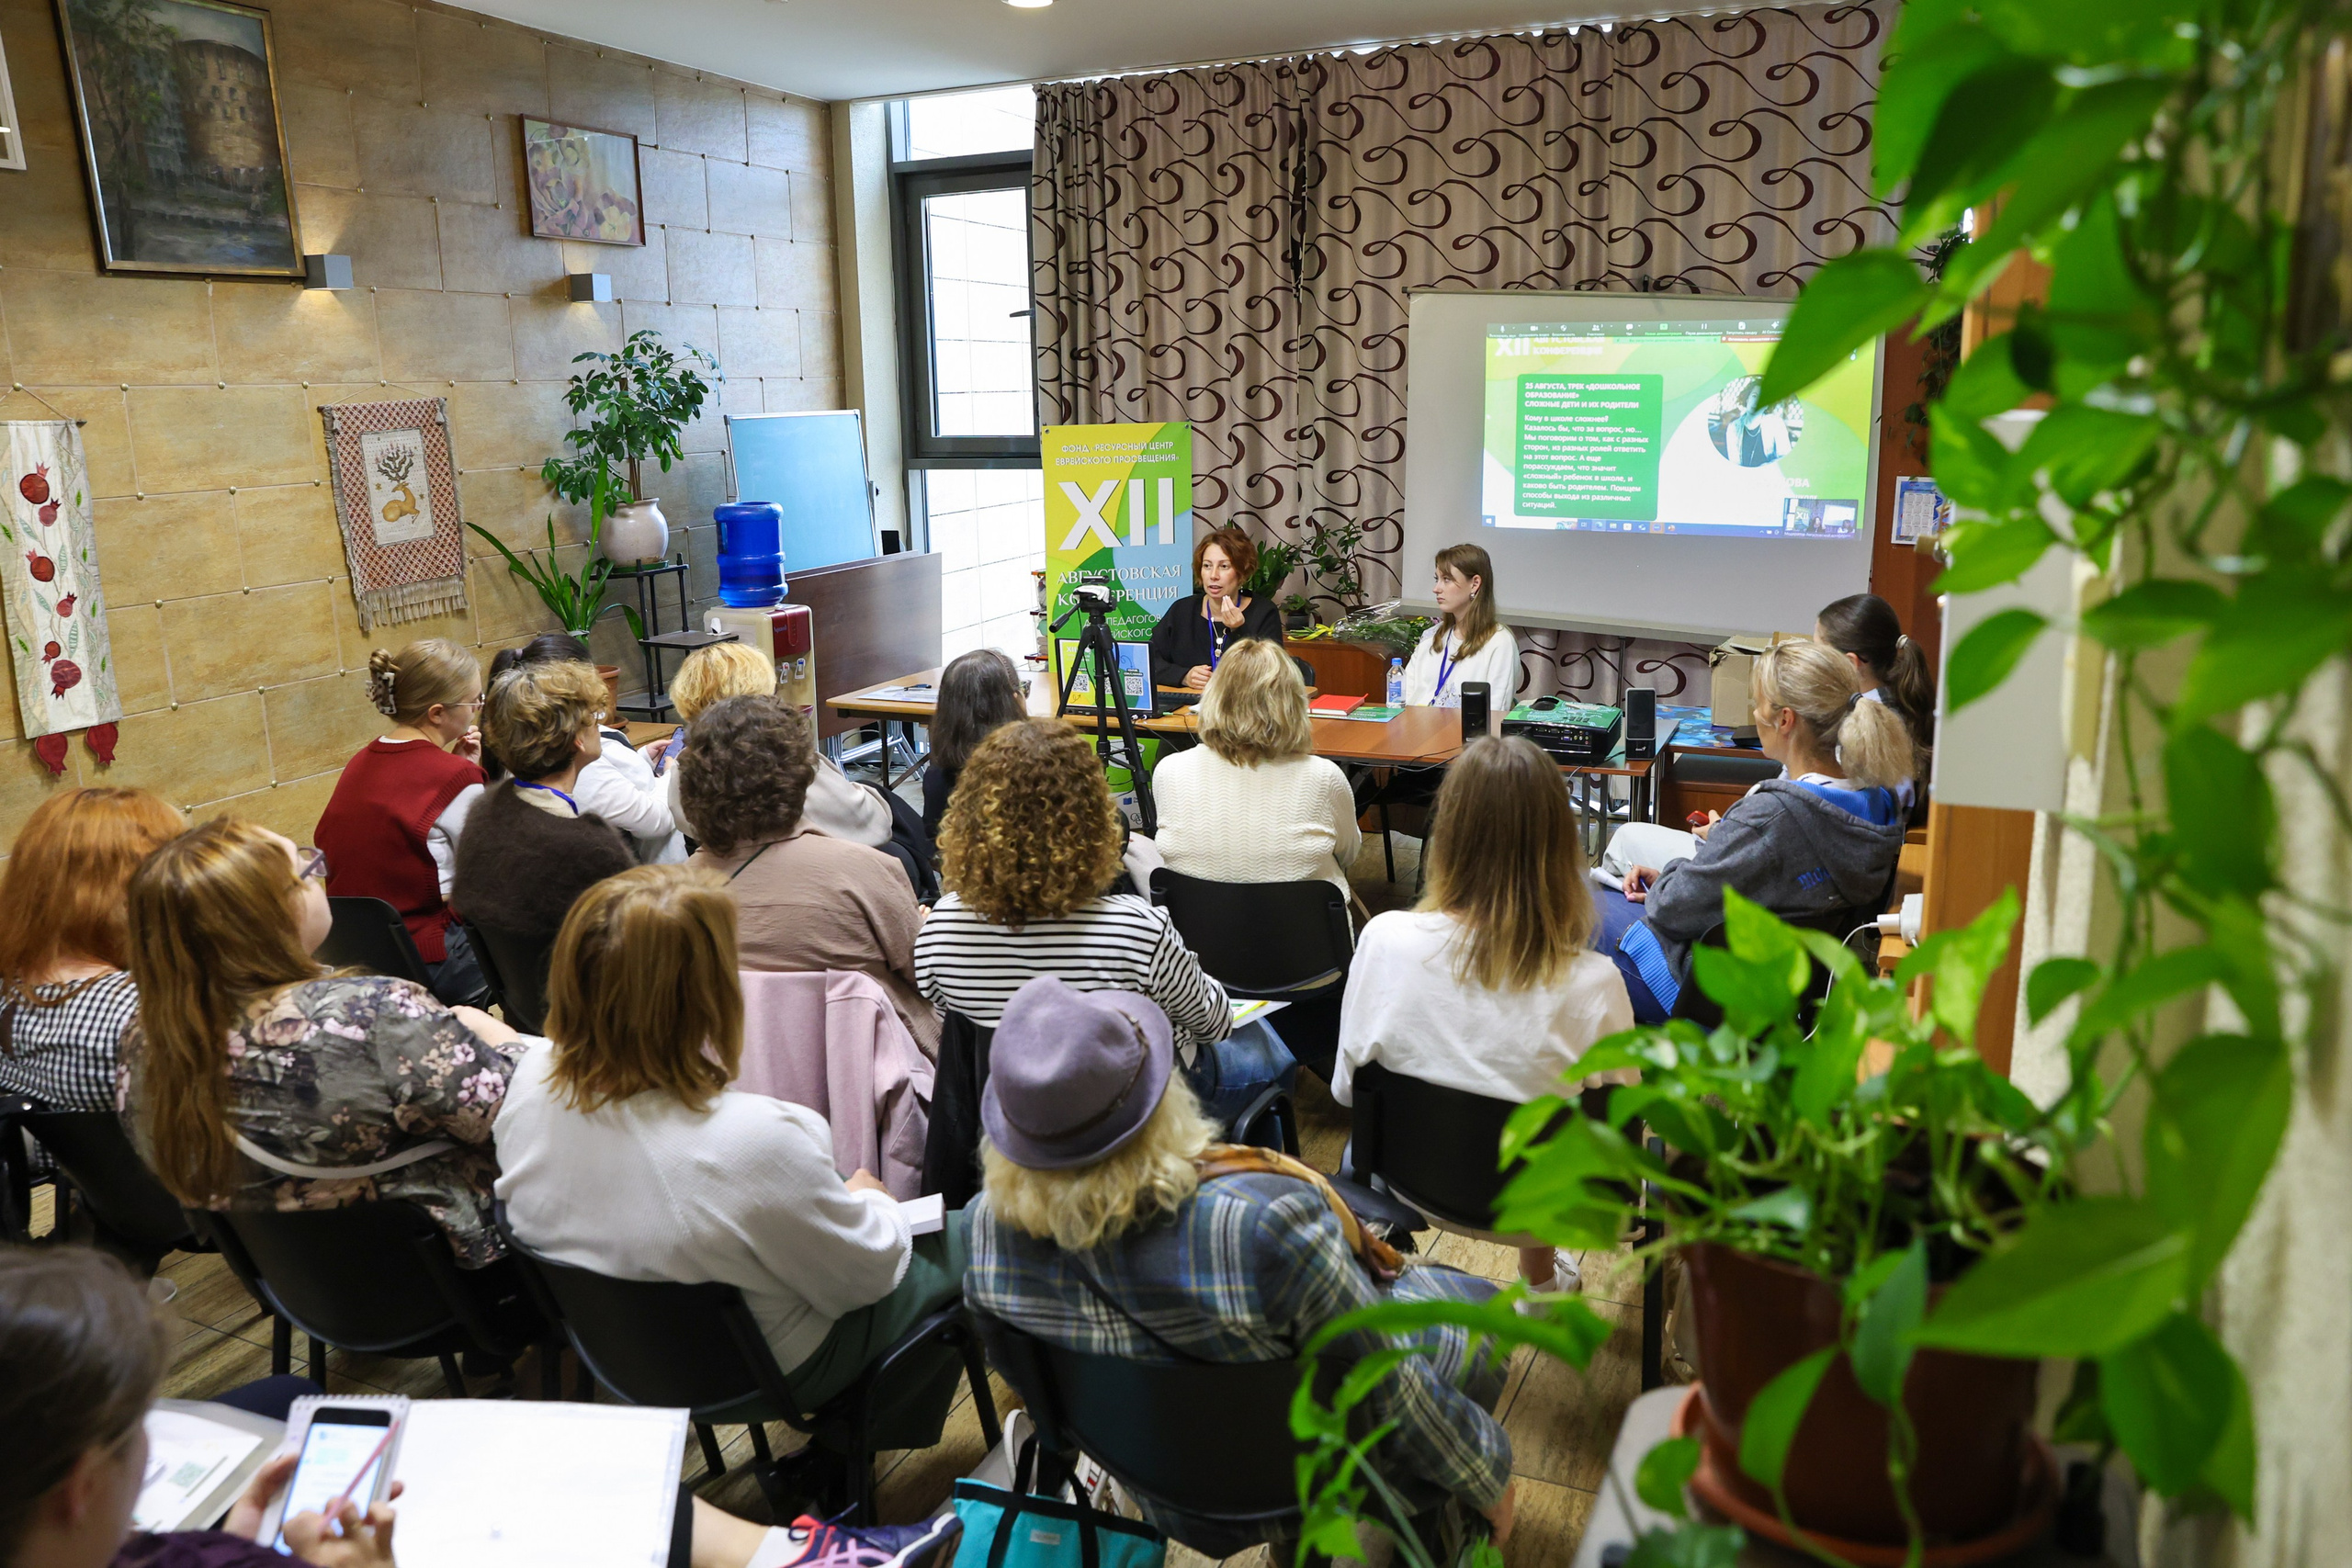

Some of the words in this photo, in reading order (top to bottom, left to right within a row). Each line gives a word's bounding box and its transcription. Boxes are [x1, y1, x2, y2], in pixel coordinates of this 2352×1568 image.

[1558, 424, 1570, 433] бы,
[1061, 444, 1090, 453] ФОНД
[1091, 441, 1148, 451] «РЕСУРСНЫЙ
[1149, 442, 1174, 450] ЦЕНТР
[1056, 456, 1112, 466] ЕВРЕЙСКОГО
[1114, 454, 1180, 463] ПРОСВЕЩЕНИЯ»
[1058, 478, 1175, 550] XII
